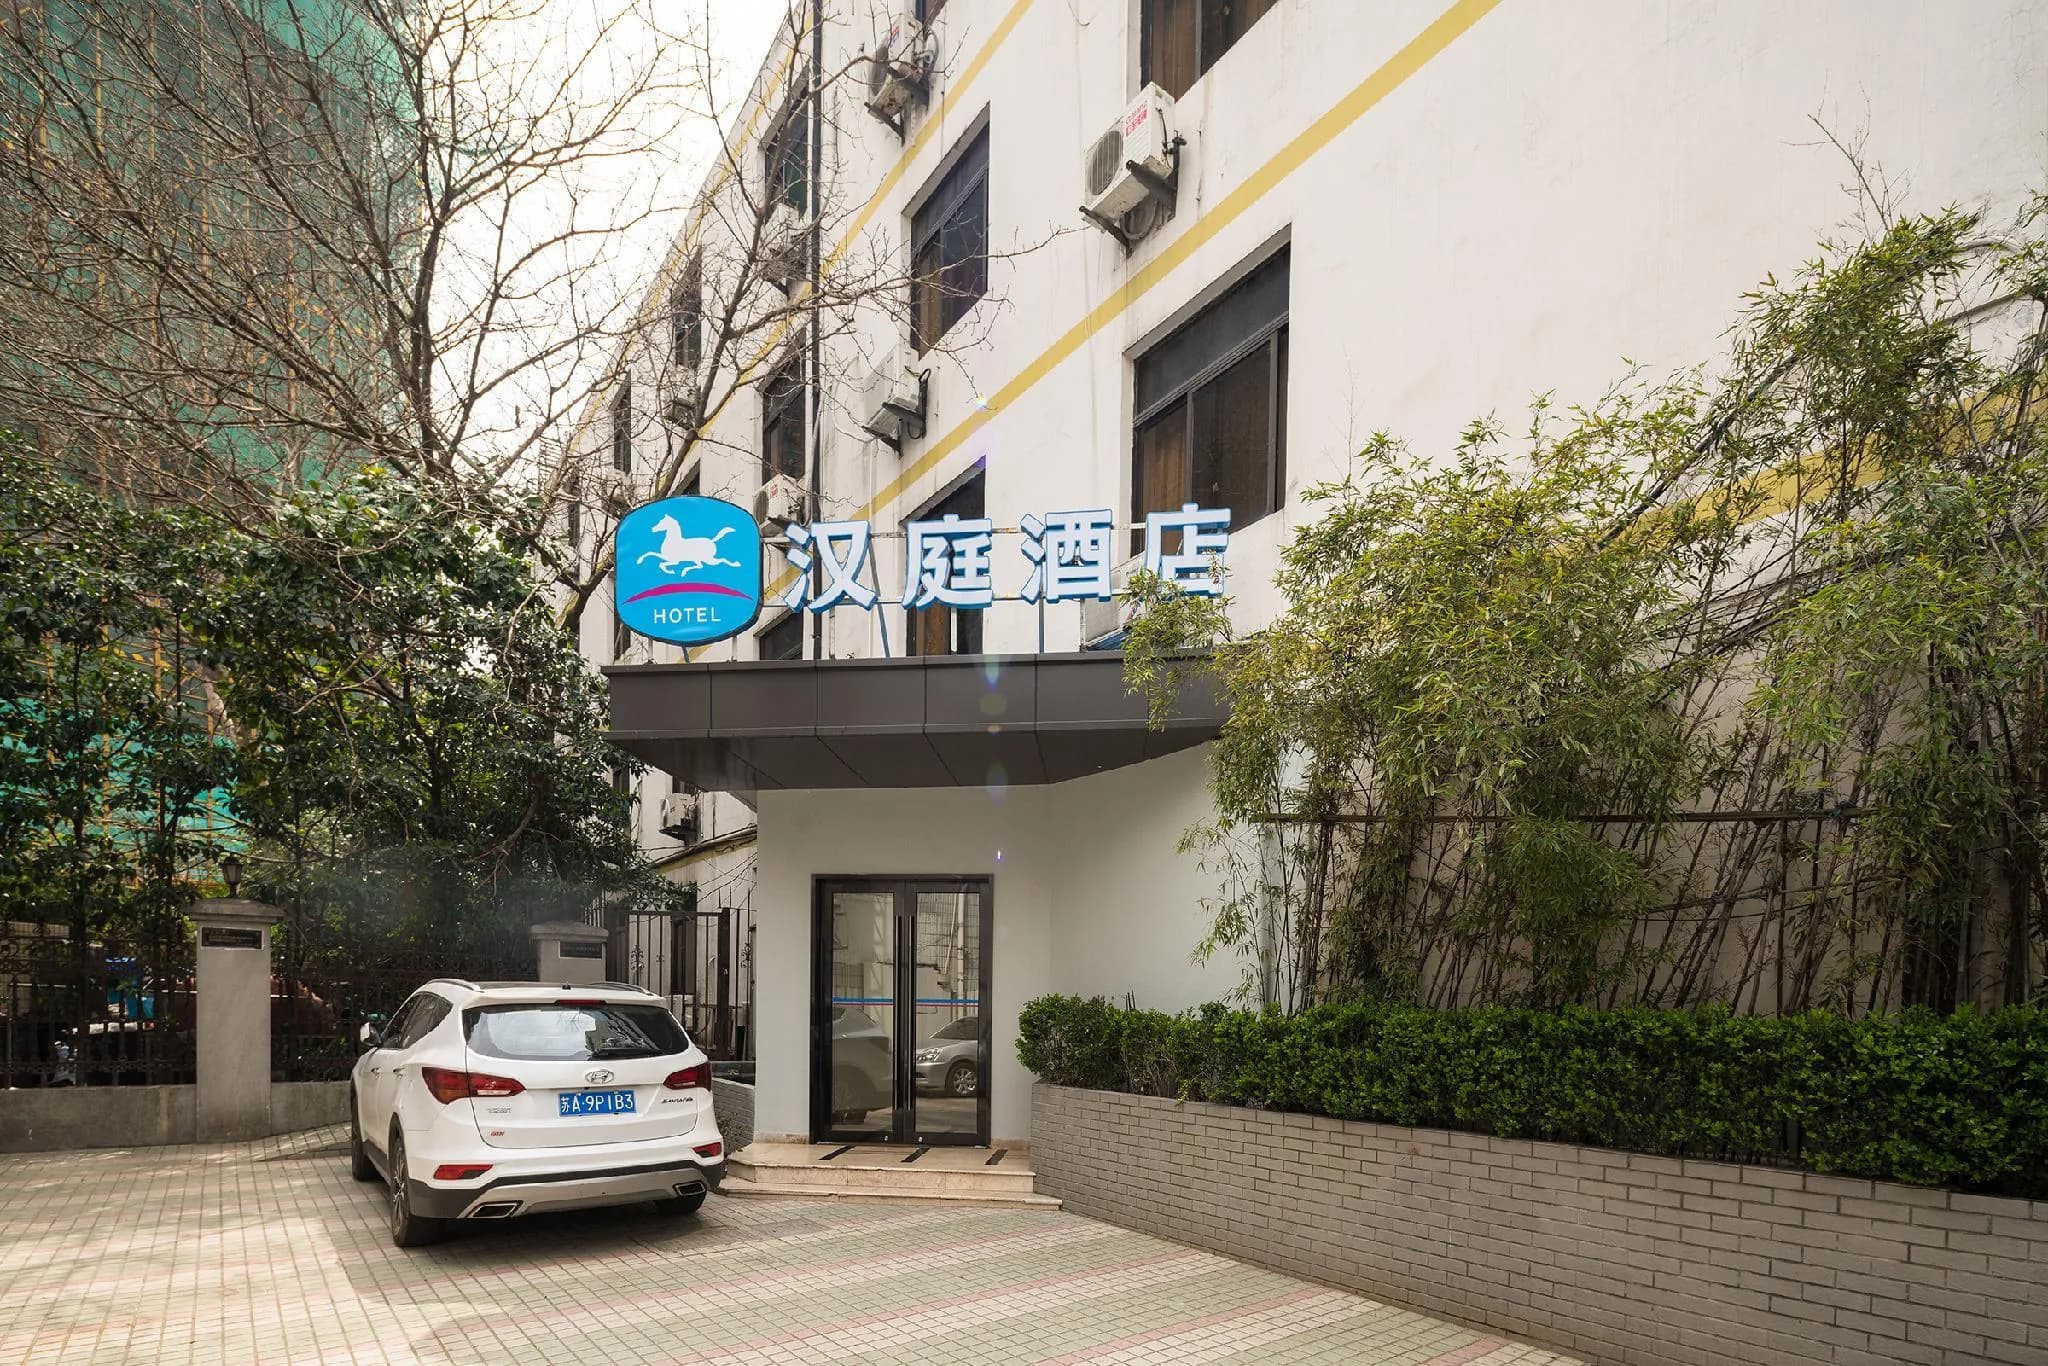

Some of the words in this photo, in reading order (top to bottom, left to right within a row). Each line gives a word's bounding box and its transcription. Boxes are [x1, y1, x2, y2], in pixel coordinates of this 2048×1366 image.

[782, 502, 1231, 613] 汉庭酒店
[653, 606, 722, 624] HOTEL
